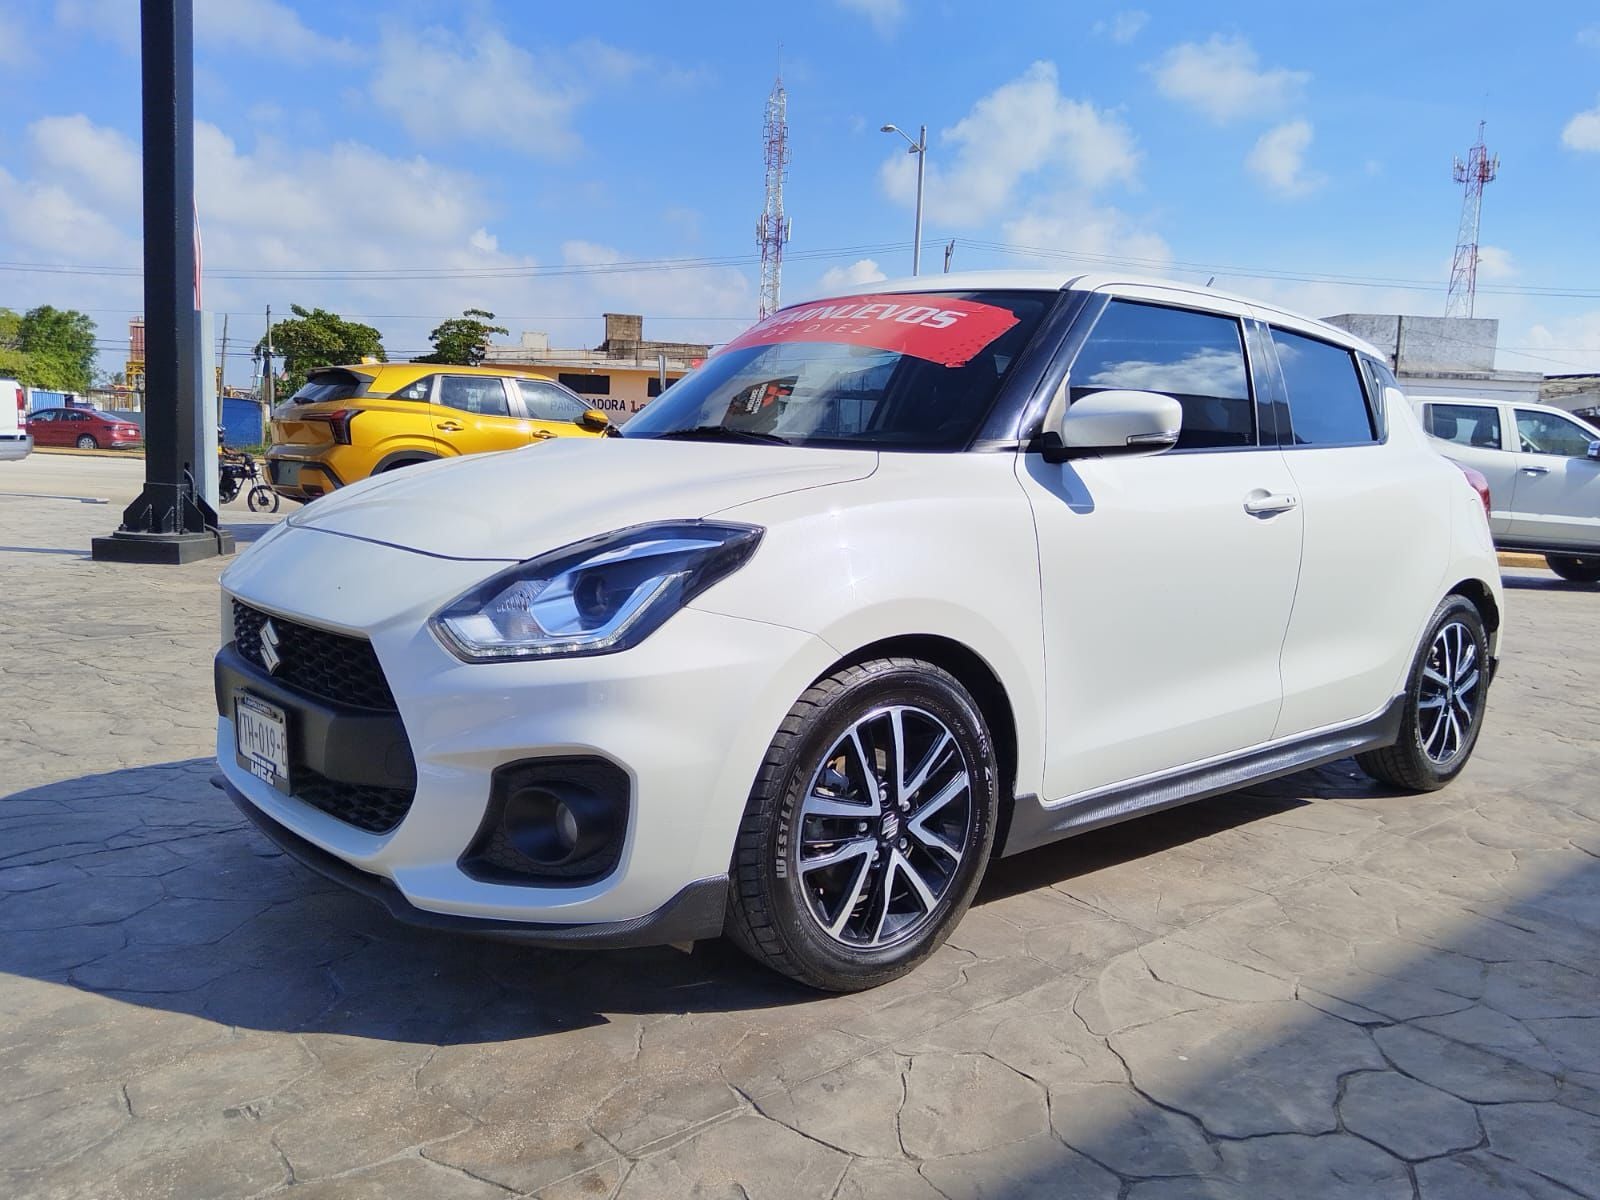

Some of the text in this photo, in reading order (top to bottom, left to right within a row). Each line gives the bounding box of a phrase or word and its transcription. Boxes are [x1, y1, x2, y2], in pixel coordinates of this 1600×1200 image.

[749, 304, 968, 334] MINUEVOS
[802, 323, 872, 334] DIEZ
[776, 766, 804, 878] WESTLAKE
